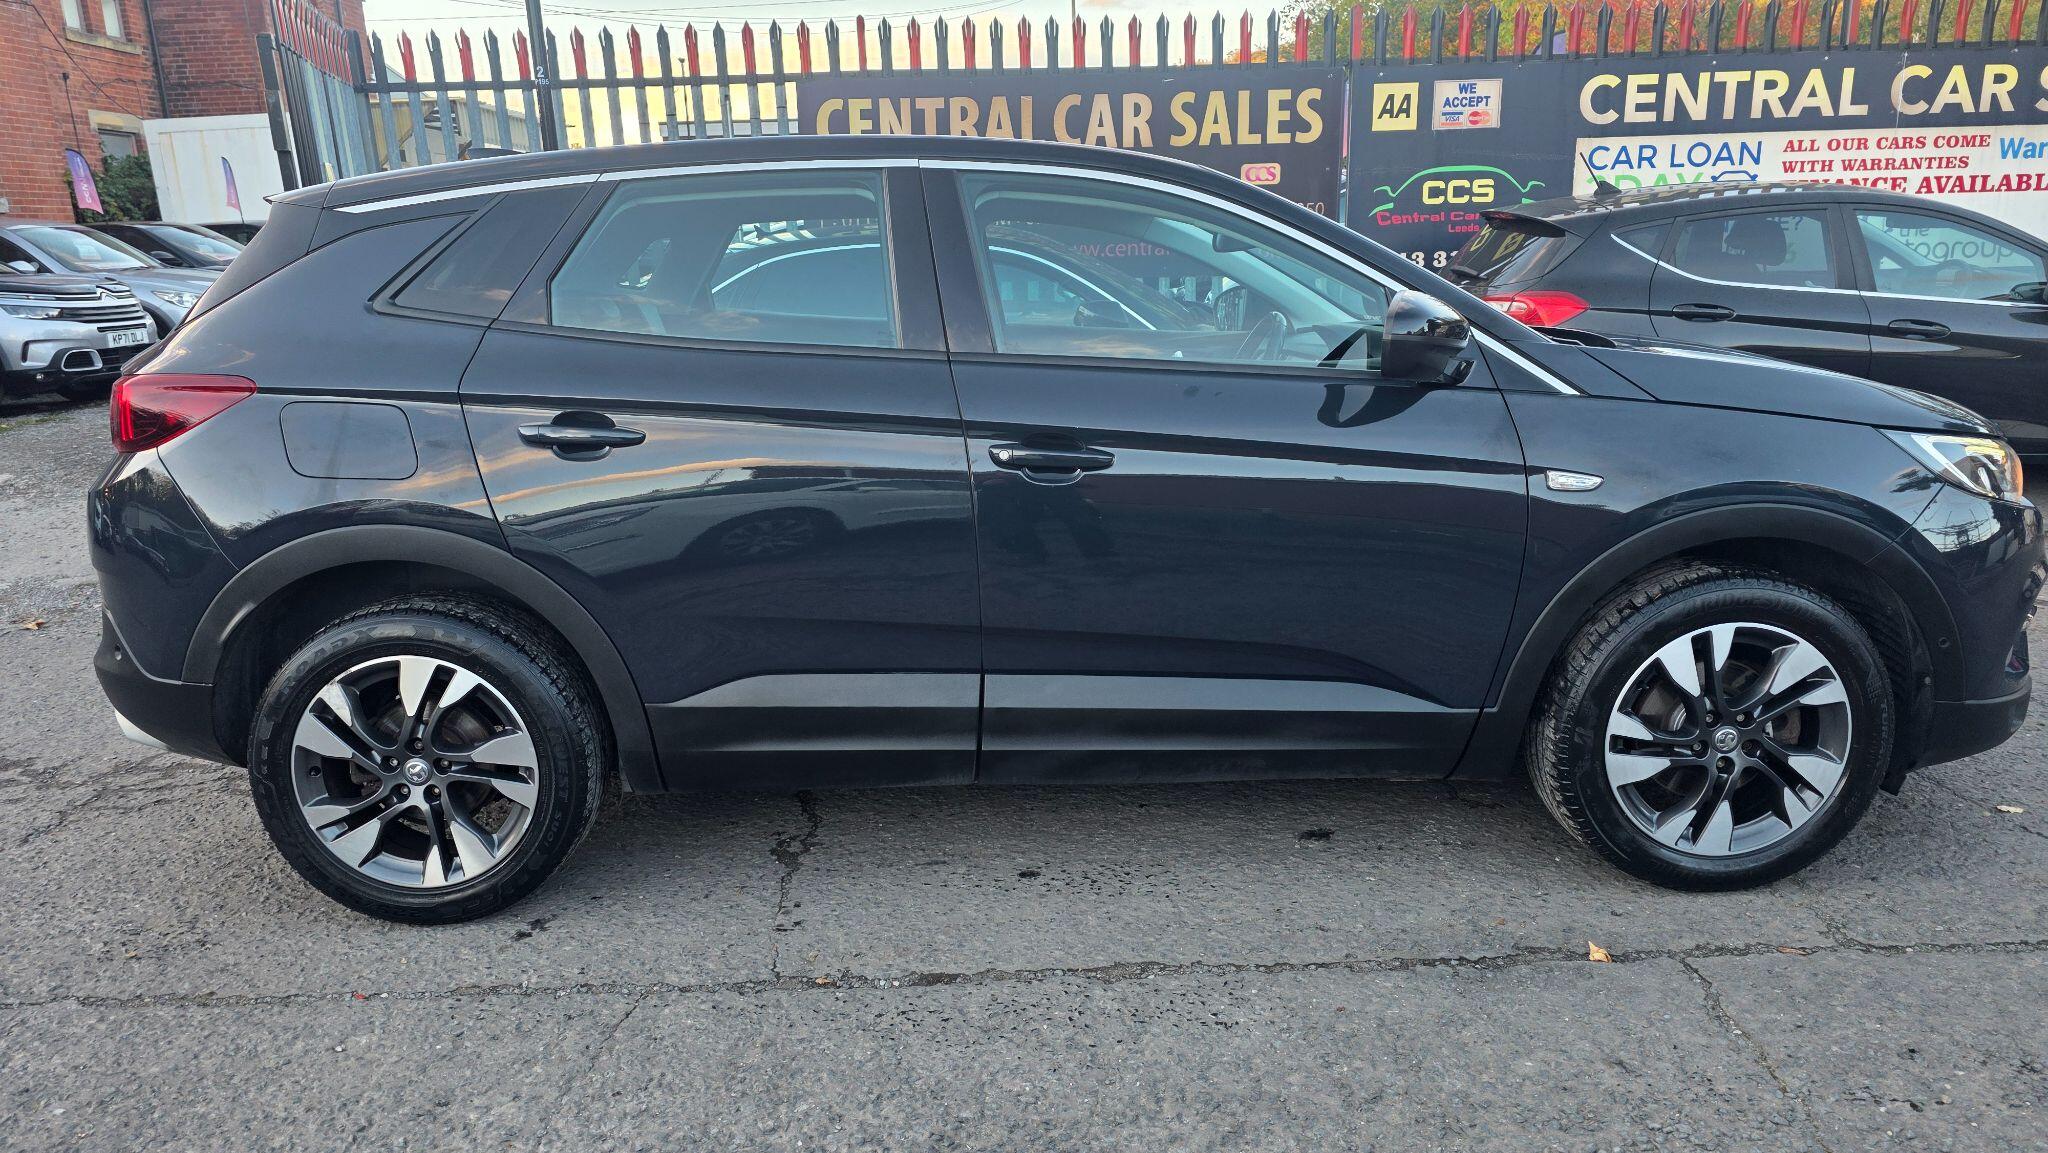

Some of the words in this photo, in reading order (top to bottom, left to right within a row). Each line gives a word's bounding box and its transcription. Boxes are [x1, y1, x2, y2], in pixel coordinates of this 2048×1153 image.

[537, 65, 545, 78] 2
[1458, 82, 1478, 99] WE
[1579, 67, 1868, 125] CENTRAL
[1890, 64, 2018, 115] CAR
[1377, 94, 1412, 119] AA
[1443, 96, 1491, 108] ACCEPT
[816, 95, 1032, 142] CENTRAL
[1053, 93, 1153, 148] CAR
[1170, 87, 1324, 147] SALES
[1783, 139, 1820, 153] ALL
[1827, 138, 1870, 152] OUR
[1876, 136, 1927, 150] CARS
[1932, 134, 1991, 149] COME
[1588, 144, 1657, 171] CAR
[1669, 141, 1763, 168] LOAN
[1782, 160, 1834, 173] WITH
[1841, 155, 1970, 172] WARRANTIES
[1245, 165, 1276, 182] CCS
[1422, 178, 1495, 205] CCS
[1376, 211, 1445, 226] Central
[1448, 224, 1480, 232] Leeds
